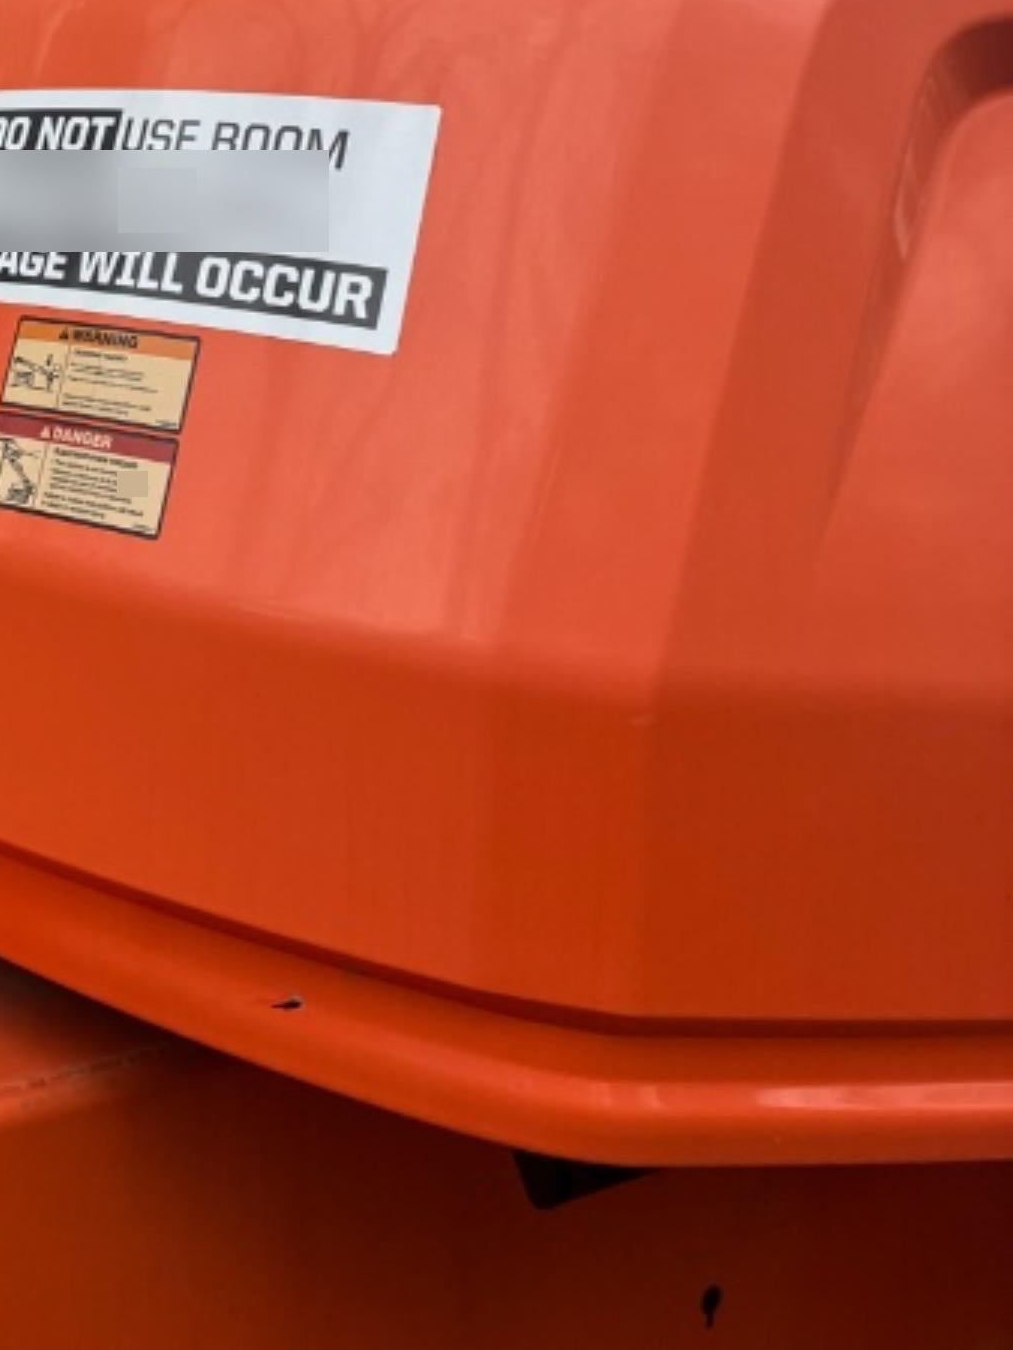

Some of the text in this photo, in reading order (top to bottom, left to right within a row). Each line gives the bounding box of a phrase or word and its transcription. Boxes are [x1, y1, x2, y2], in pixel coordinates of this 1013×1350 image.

[35, 116, 120, 150] NOT
[78, 251, 184, 293] WILL
[195, 255, 376, 320] OCCUR
[73, 328, 138, 349] WARNING
[52, 425, 113, 449] DANGER
